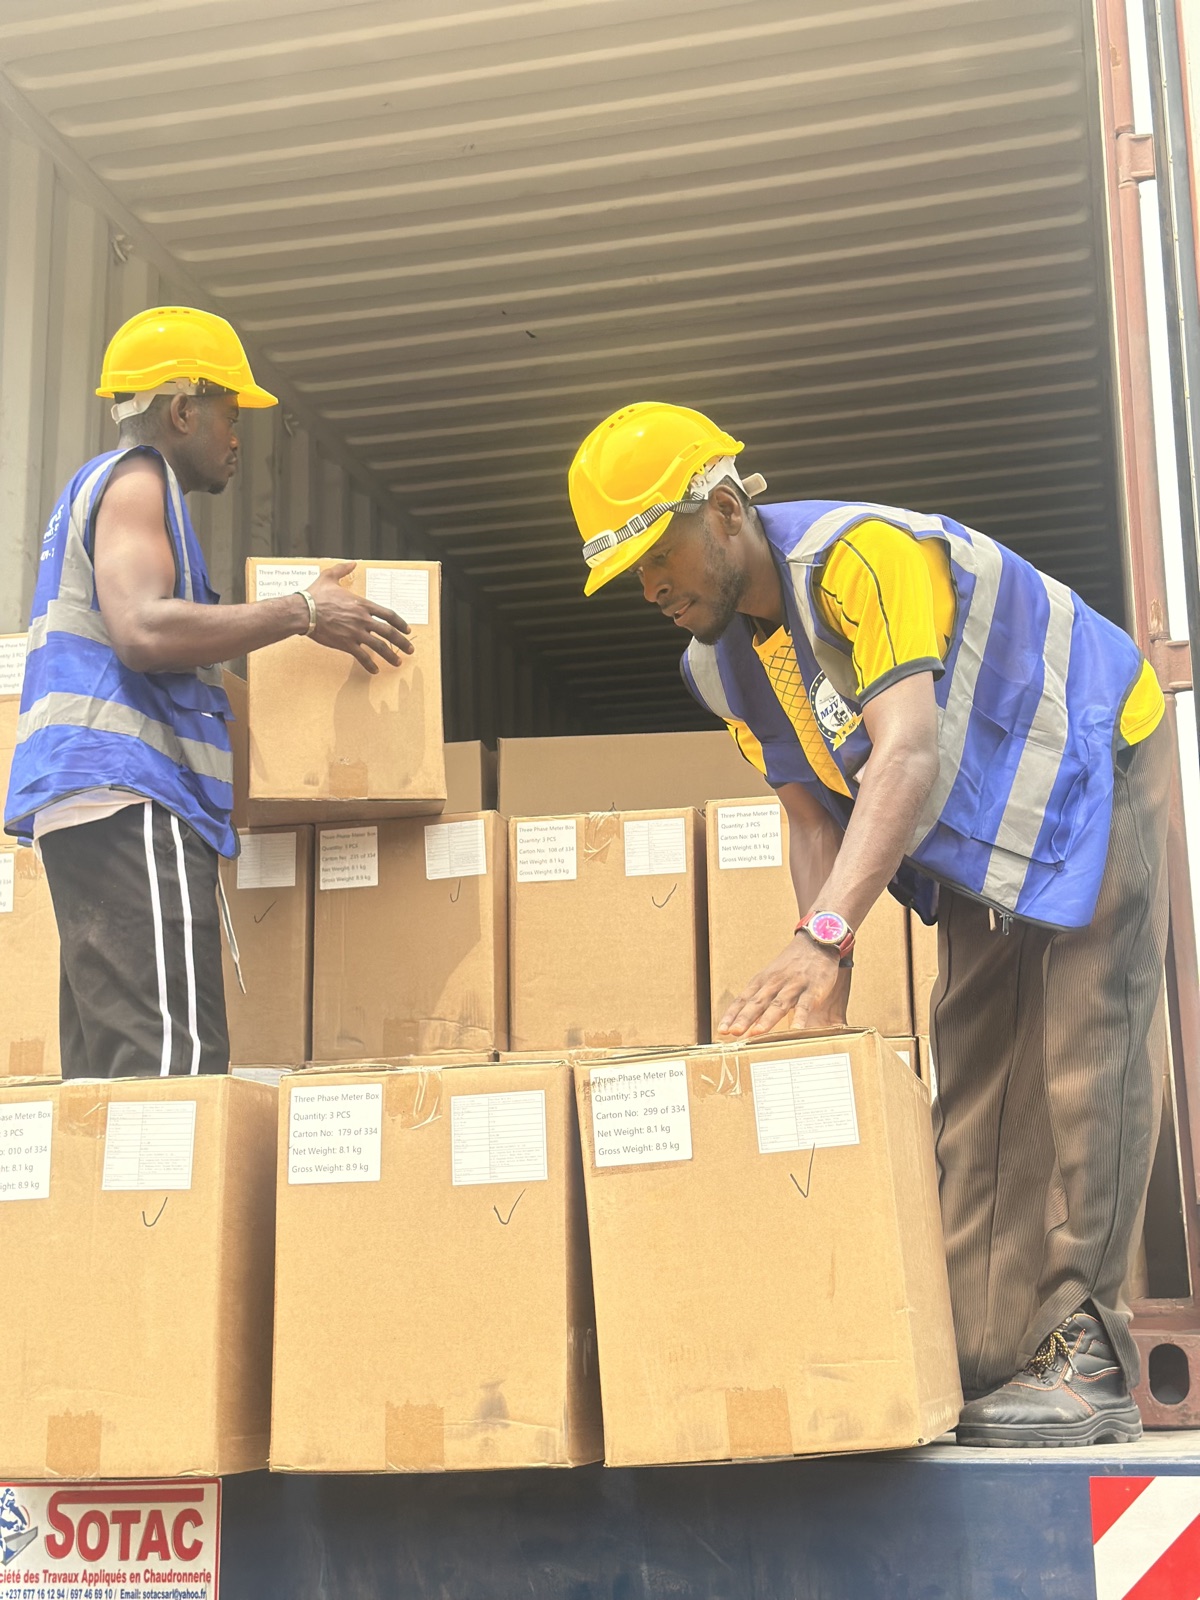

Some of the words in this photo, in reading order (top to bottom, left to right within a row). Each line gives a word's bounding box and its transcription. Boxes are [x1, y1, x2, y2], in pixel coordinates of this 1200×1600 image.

[820, 700, 838, 720] MJV
[595, 1093, 630, 1102] Quantity:
[596, 1111, 622, 1120] Carton
[660, 1106, 669, 1114] of
[671, 1105, 685, 1113] 334
[614, 1127, 644, 1137] Weight:
[661, 1124, 670, 1133] kg
[308, 1147, 336, 1156] Weight:
[353, 1146, 361, 1154] kg
[622, 1144, 653, 1154] Weight:
[656, 1142, 667, 1150] 8.9
[670, 1142, 680, 1151] kg
[25, 1164, 33, 1172] kg
[315, 1164, 344, 1173] Weight:
[360, 1163, 368, 1172] kg
[31, 1181, 39, 1190] kg
[45, 1488, 204, 1561] SOTAC
[23, 1569, 39, 1583] des
[43, 1570, 78, 1583] Travaux
[82, 1569, 126, 1586] Appliqués
[130, 1572, 140, 1583] en
[144, 1569, 211, 1583] Chaudronnerie
[6, 1589, 21, 1599] +237
[23, 1589, 35, 1599] 677
[37, 1589, 45, 1599] 16
[47, 1589, 54, 1599] 12
[57, 1589, 64, 1599] 94
[70, 1589, 82, 1599] 697
[84, 1589, 92, 1599] 46
[95, 1589, 102, 1599] 69
[105, 1589, 112, 1599] 10
[120, 1589, 141, 1599] Email:
